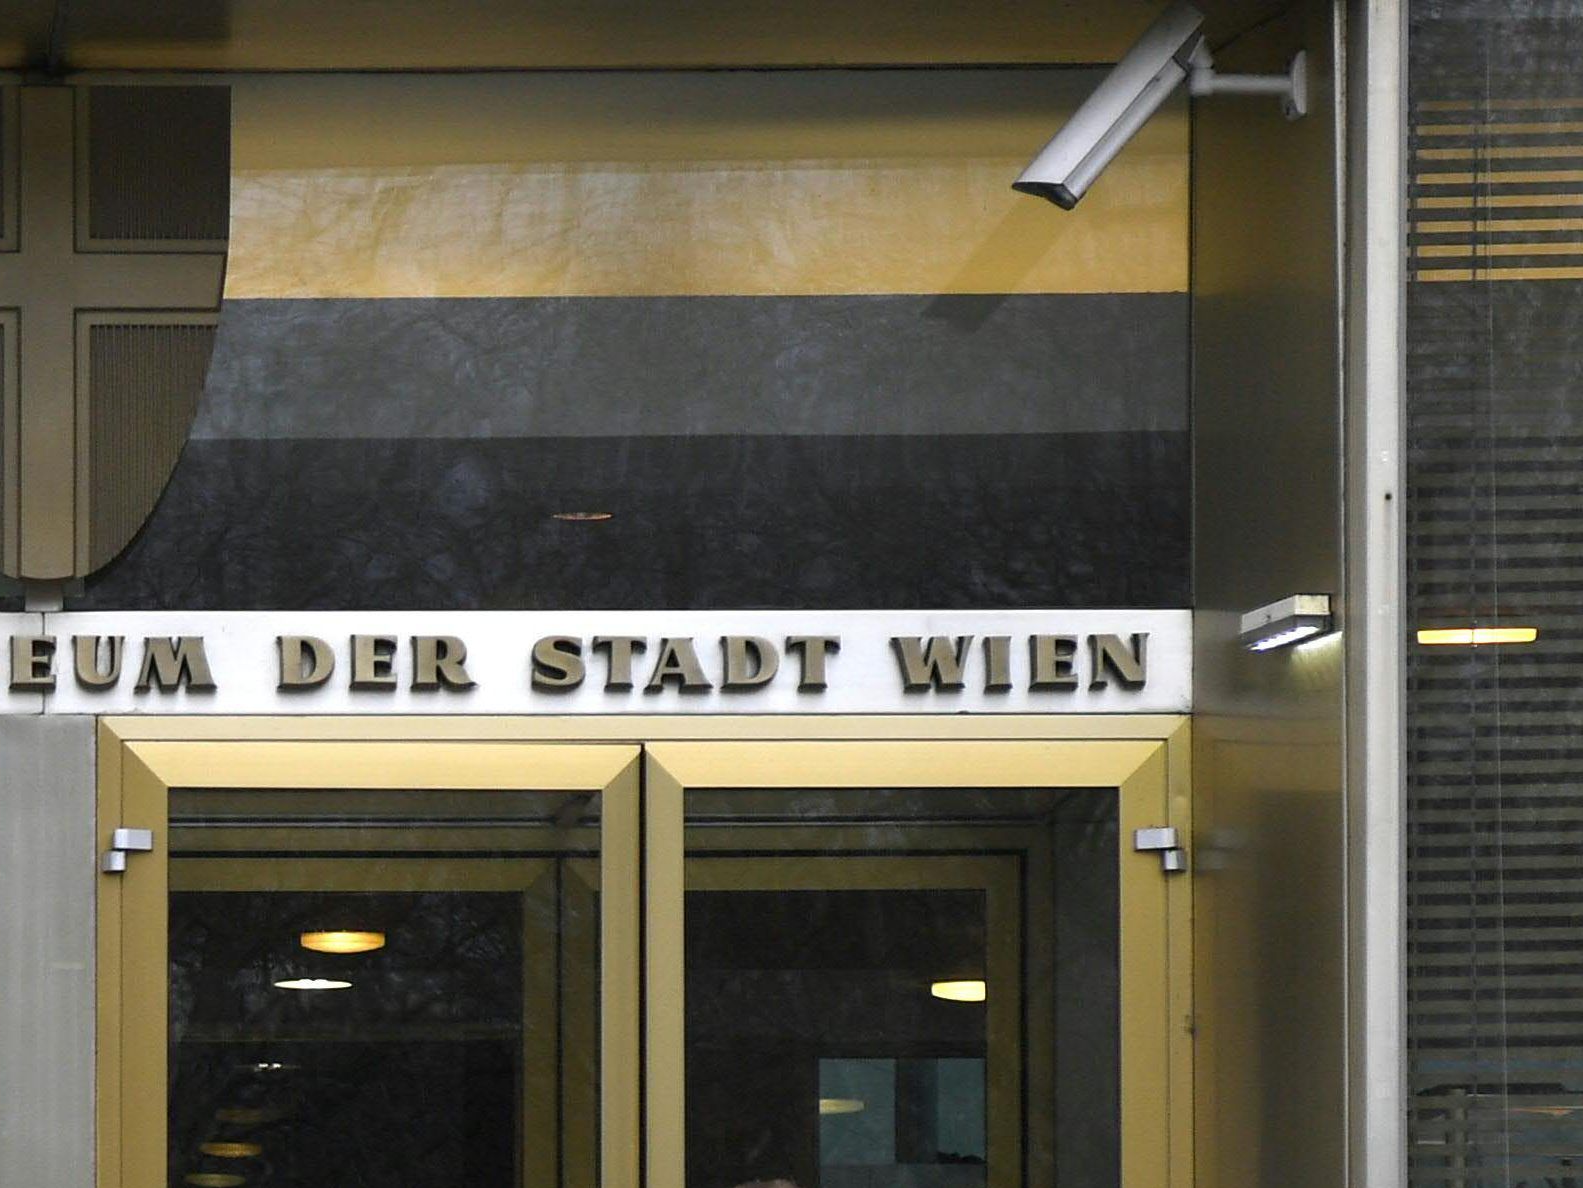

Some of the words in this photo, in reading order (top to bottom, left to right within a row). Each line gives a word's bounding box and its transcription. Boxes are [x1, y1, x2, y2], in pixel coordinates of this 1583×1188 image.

[276, 634, 476, 693] DER
[531, 635, 840, 694] STADT
[889, 633, 1148, 693] WIEN
